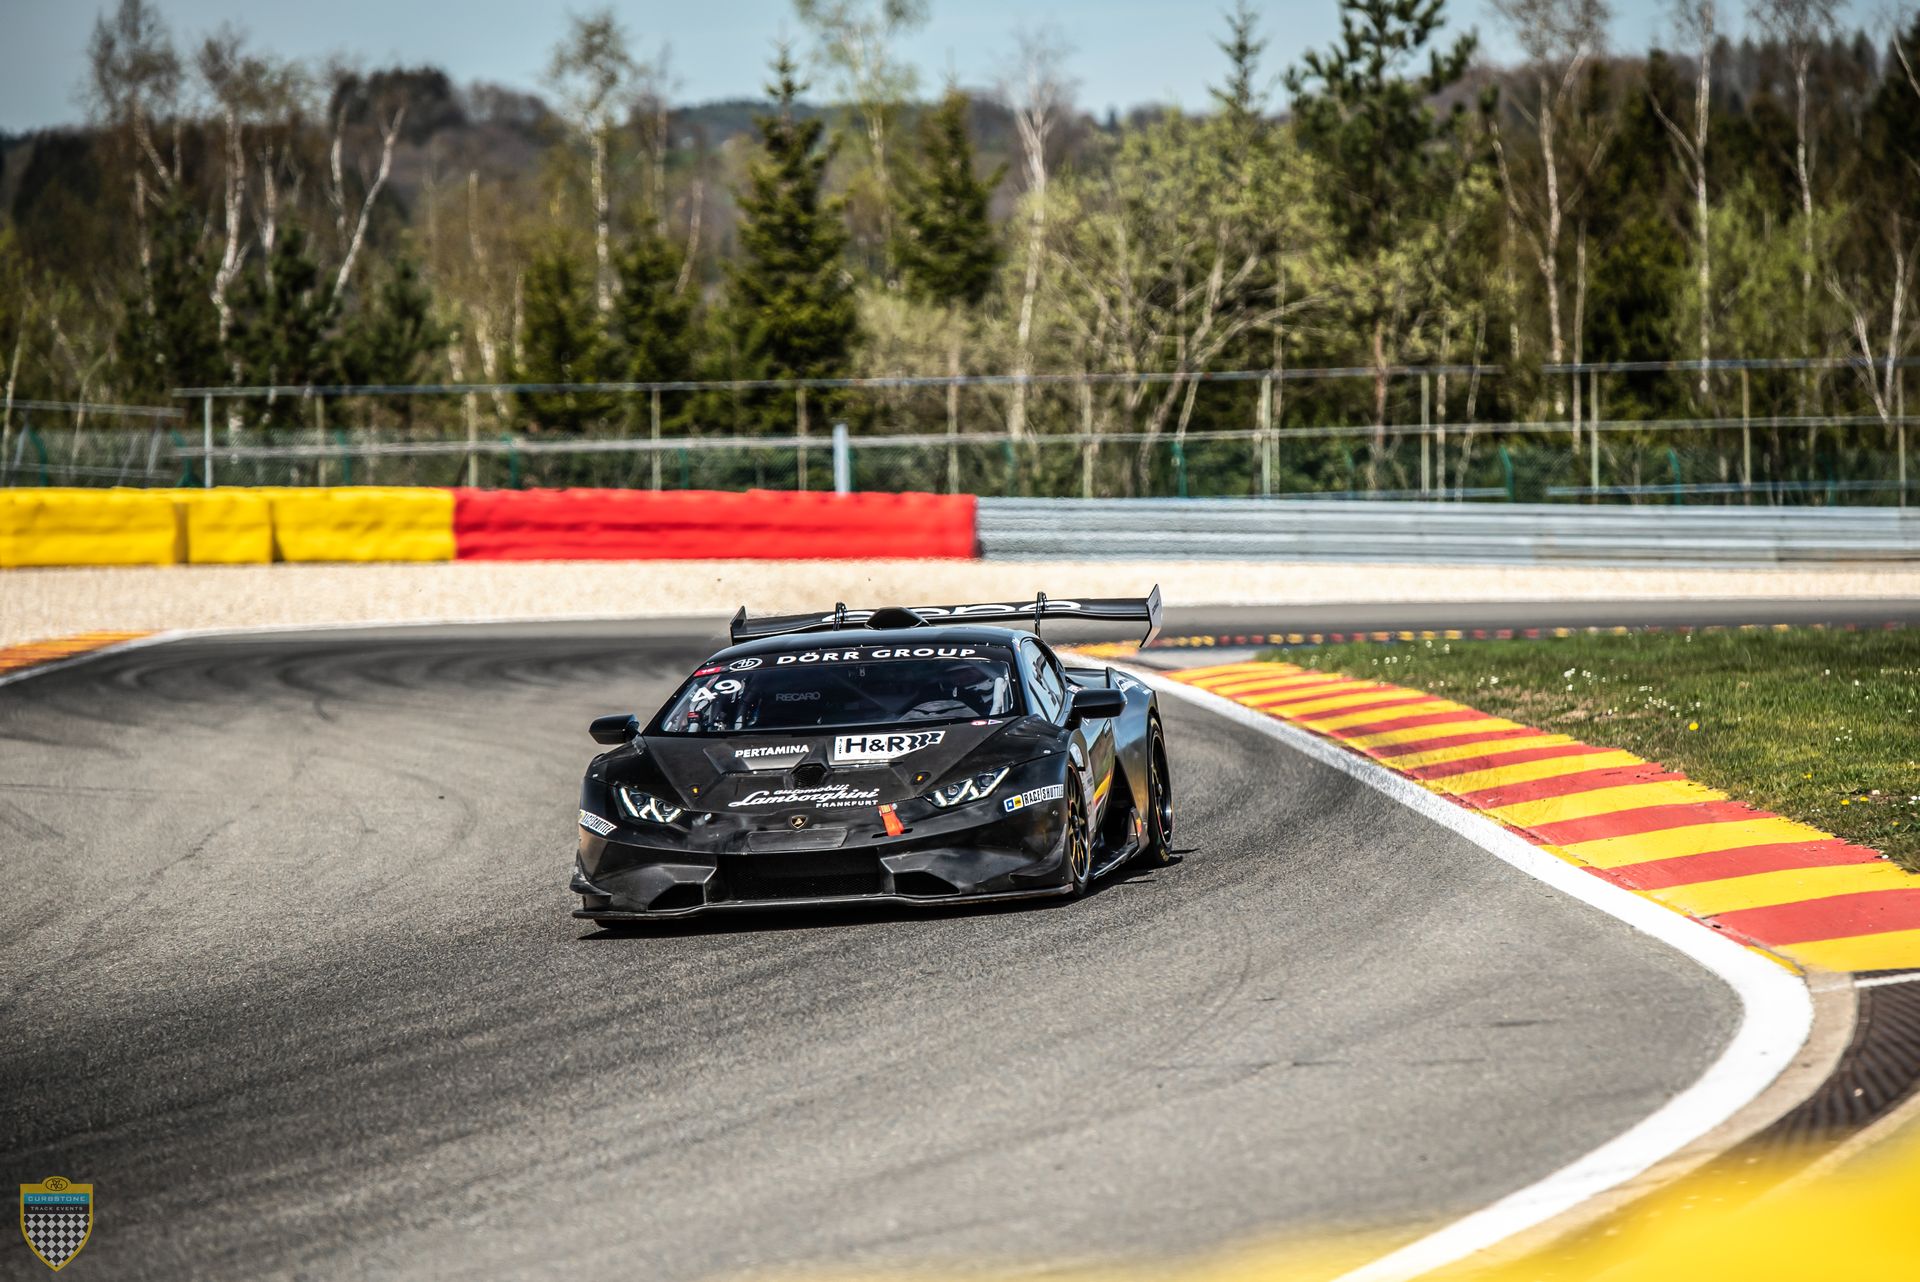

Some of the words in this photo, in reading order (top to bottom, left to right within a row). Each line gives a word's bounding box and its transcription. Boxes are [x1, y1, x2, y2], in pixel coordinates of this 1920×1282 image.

[776, 652, 859, 665] DÖRR
[872, 648, 976, 658] GROUP
[691, 679, 742, 702] 49
[776, 691, 821, 701] RECARO
[735, 744, 809, 758] PERTAMINA
[845, 736, 905, 753] H&R
[774, 784, 850, 795] automobili
[728, 788, 880, 807] Lamborghini
[816, 800, 879, 808] FRANKFURT
[1023, 790, 1041, 804] RACE
